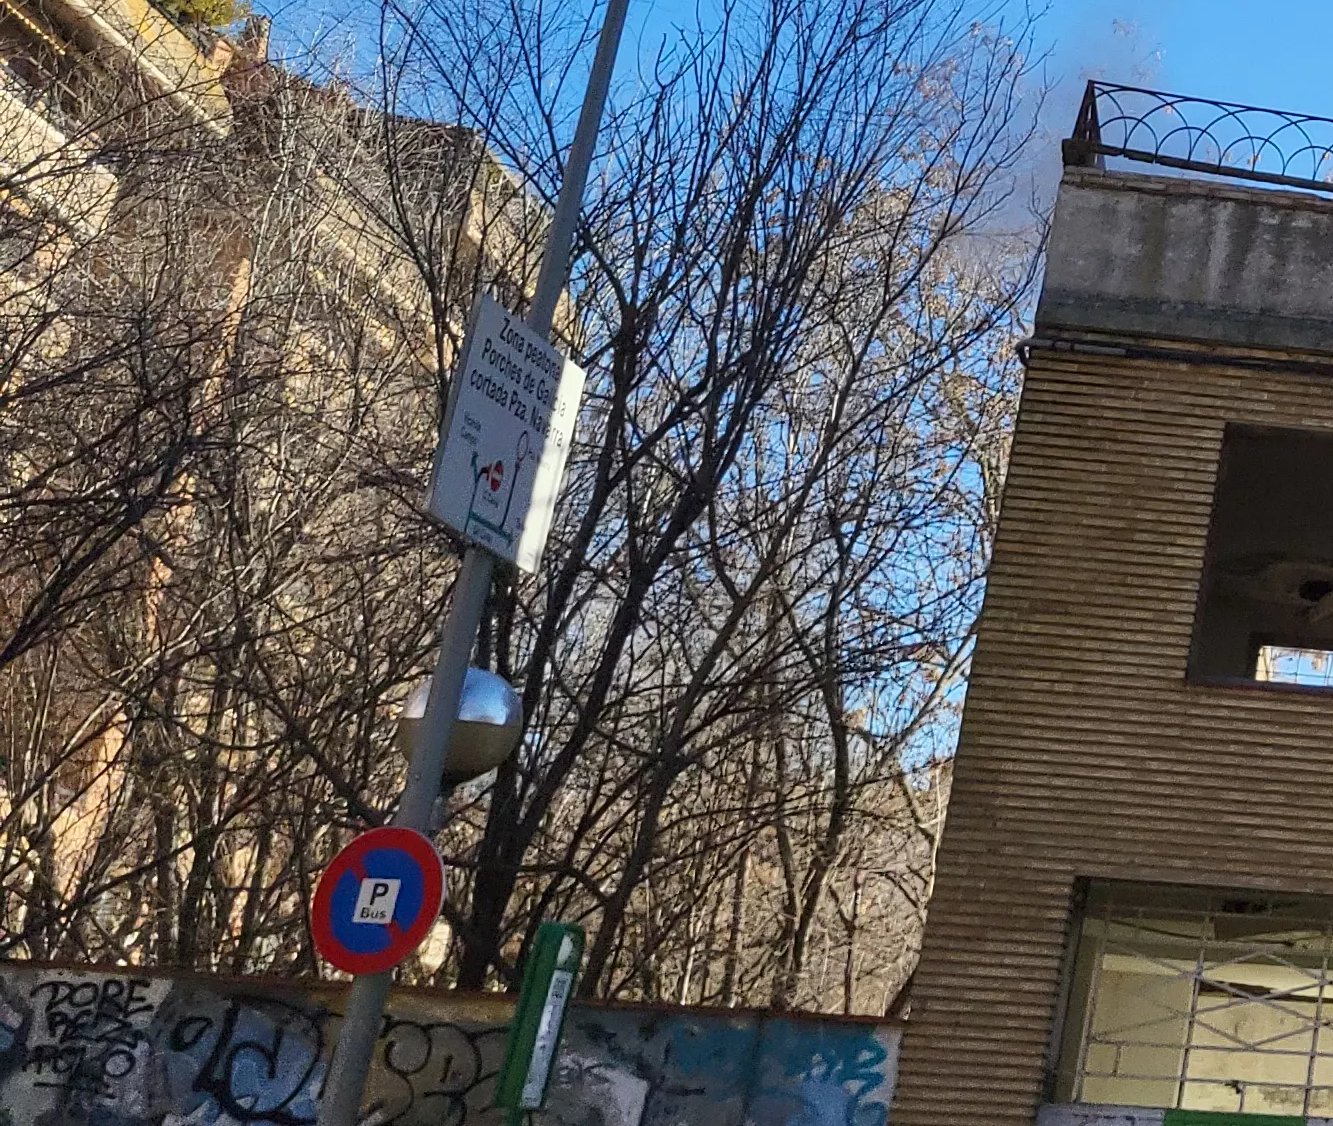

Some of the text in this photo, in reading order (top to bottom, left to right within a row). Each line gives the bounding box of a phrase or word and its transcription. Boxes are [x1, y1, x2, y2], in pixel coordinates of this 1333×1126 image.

[500, 317, 525, 353] Zona
[482, 338, 522, 384] Porches
[524, 372, 535, 394] de
[471, 369, 508, 407] cortada
[509, 390, 527, 423] Pza.
[369, 883, 389, 906] P
[360, 907, 387, 919] Bus
